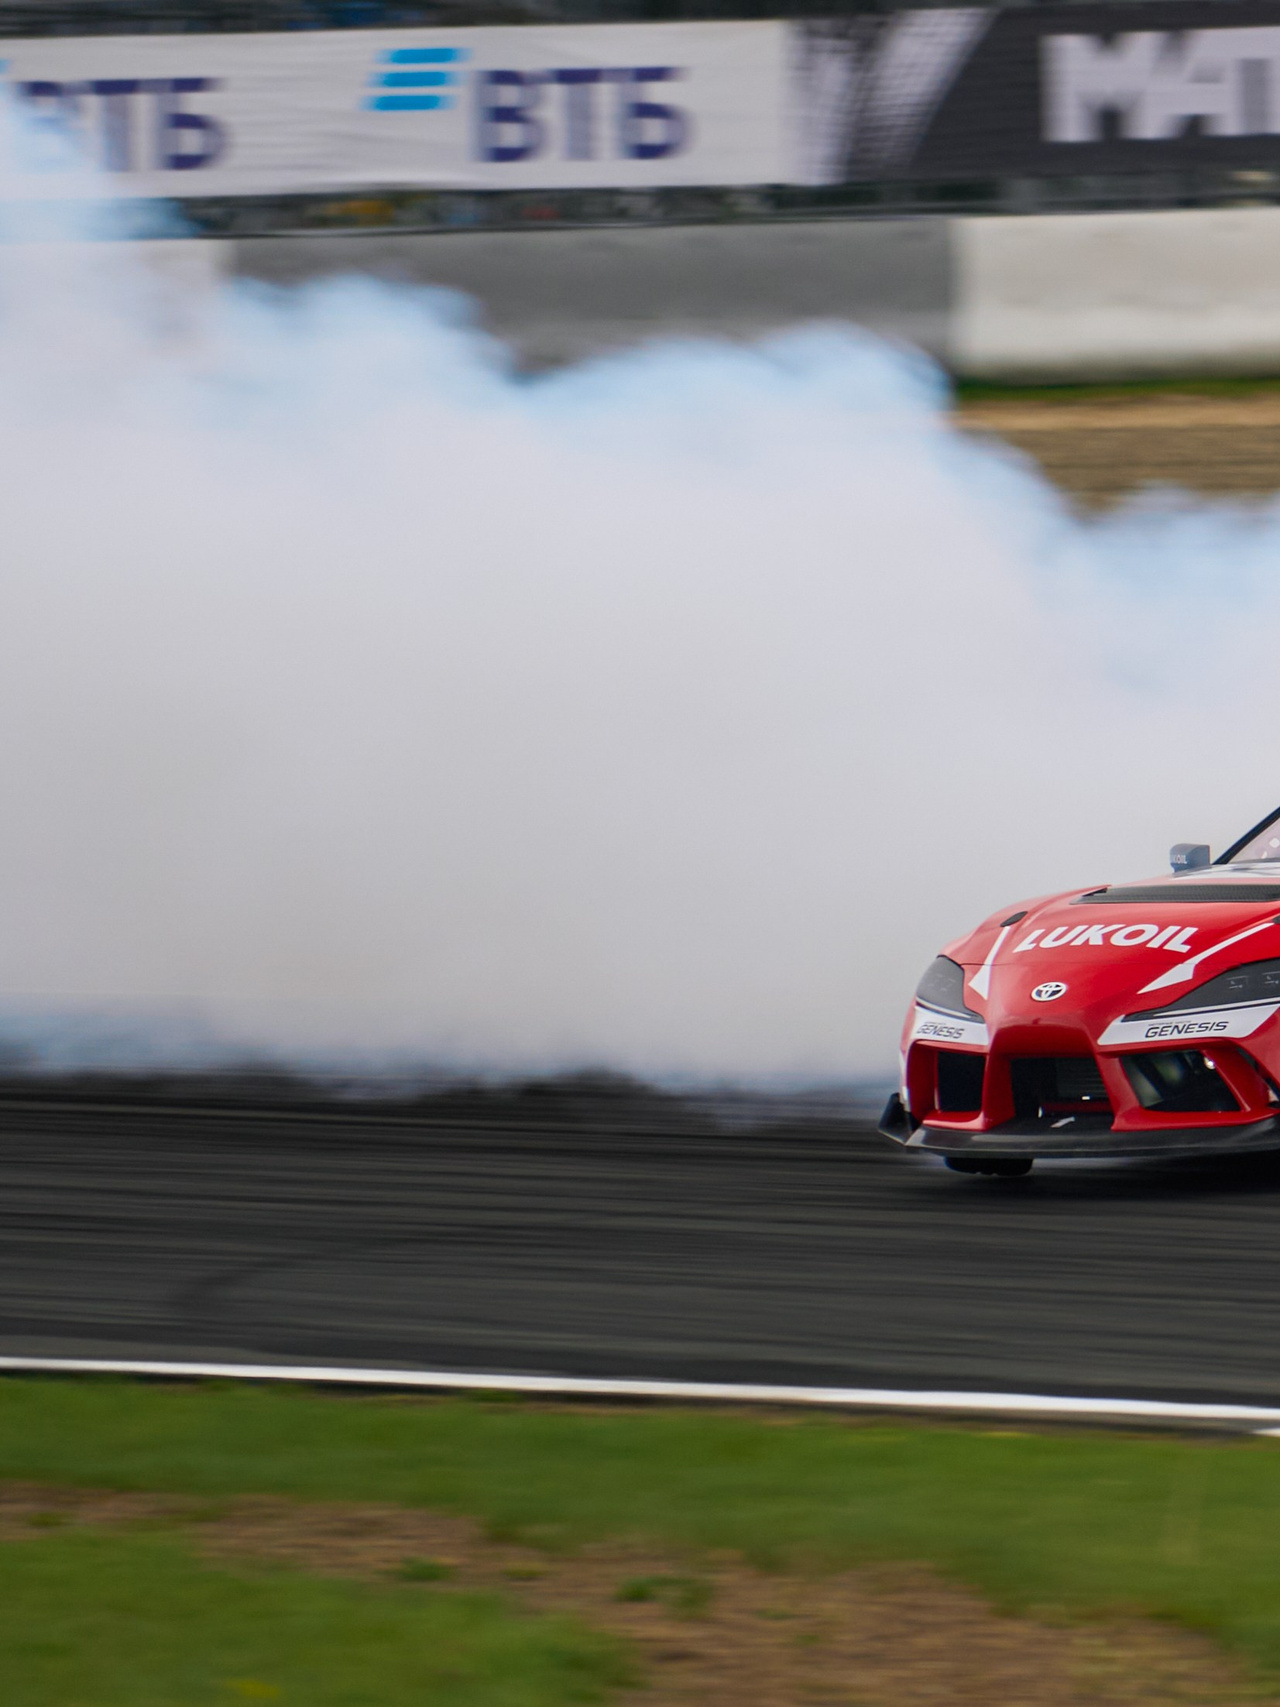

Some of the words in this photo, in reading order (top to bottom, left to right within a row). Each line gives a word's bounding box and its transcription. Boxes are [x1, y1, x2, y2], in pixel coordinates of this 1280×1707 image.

[473, 67, 690, 162] ВТБ
[1012, 923, 1199, 954] LUKOIL
[916, 1024, 965, 1039] GENESIS
[1144, 1021, 1230, 1039] GENESIS
